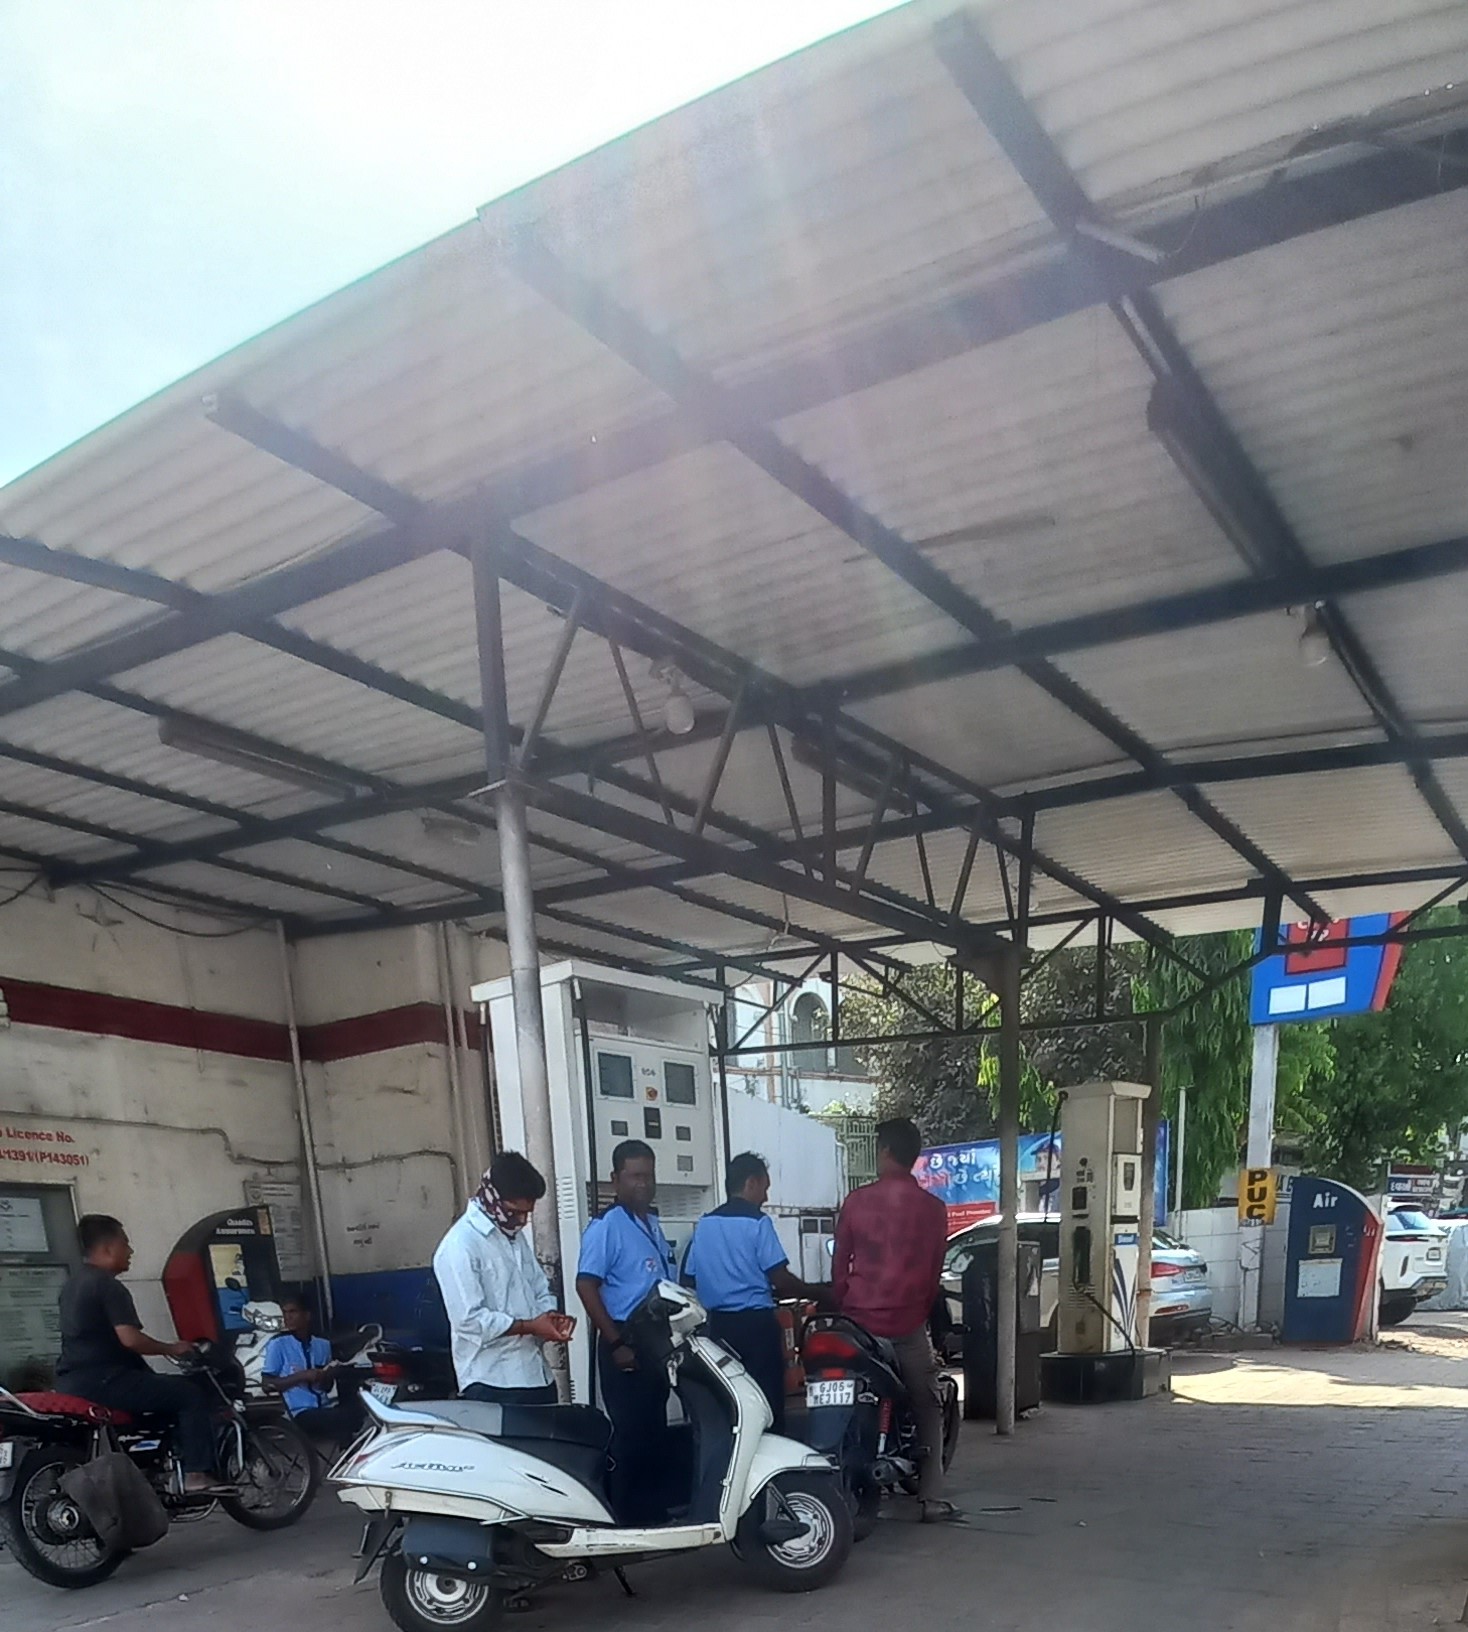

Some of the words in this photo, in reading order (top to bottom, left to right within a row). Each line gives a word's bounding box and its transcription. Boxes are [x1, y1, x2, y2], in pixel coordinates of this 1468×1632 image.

[5, 1127, 53, 1141] Licence
[56, 1131, 75, 1143] No.
[1246, 1170, 1268, 1220] PUC
[1313, 1192, 1338, 1208] Air
[820, 1381, 845, 1393] GJ05
